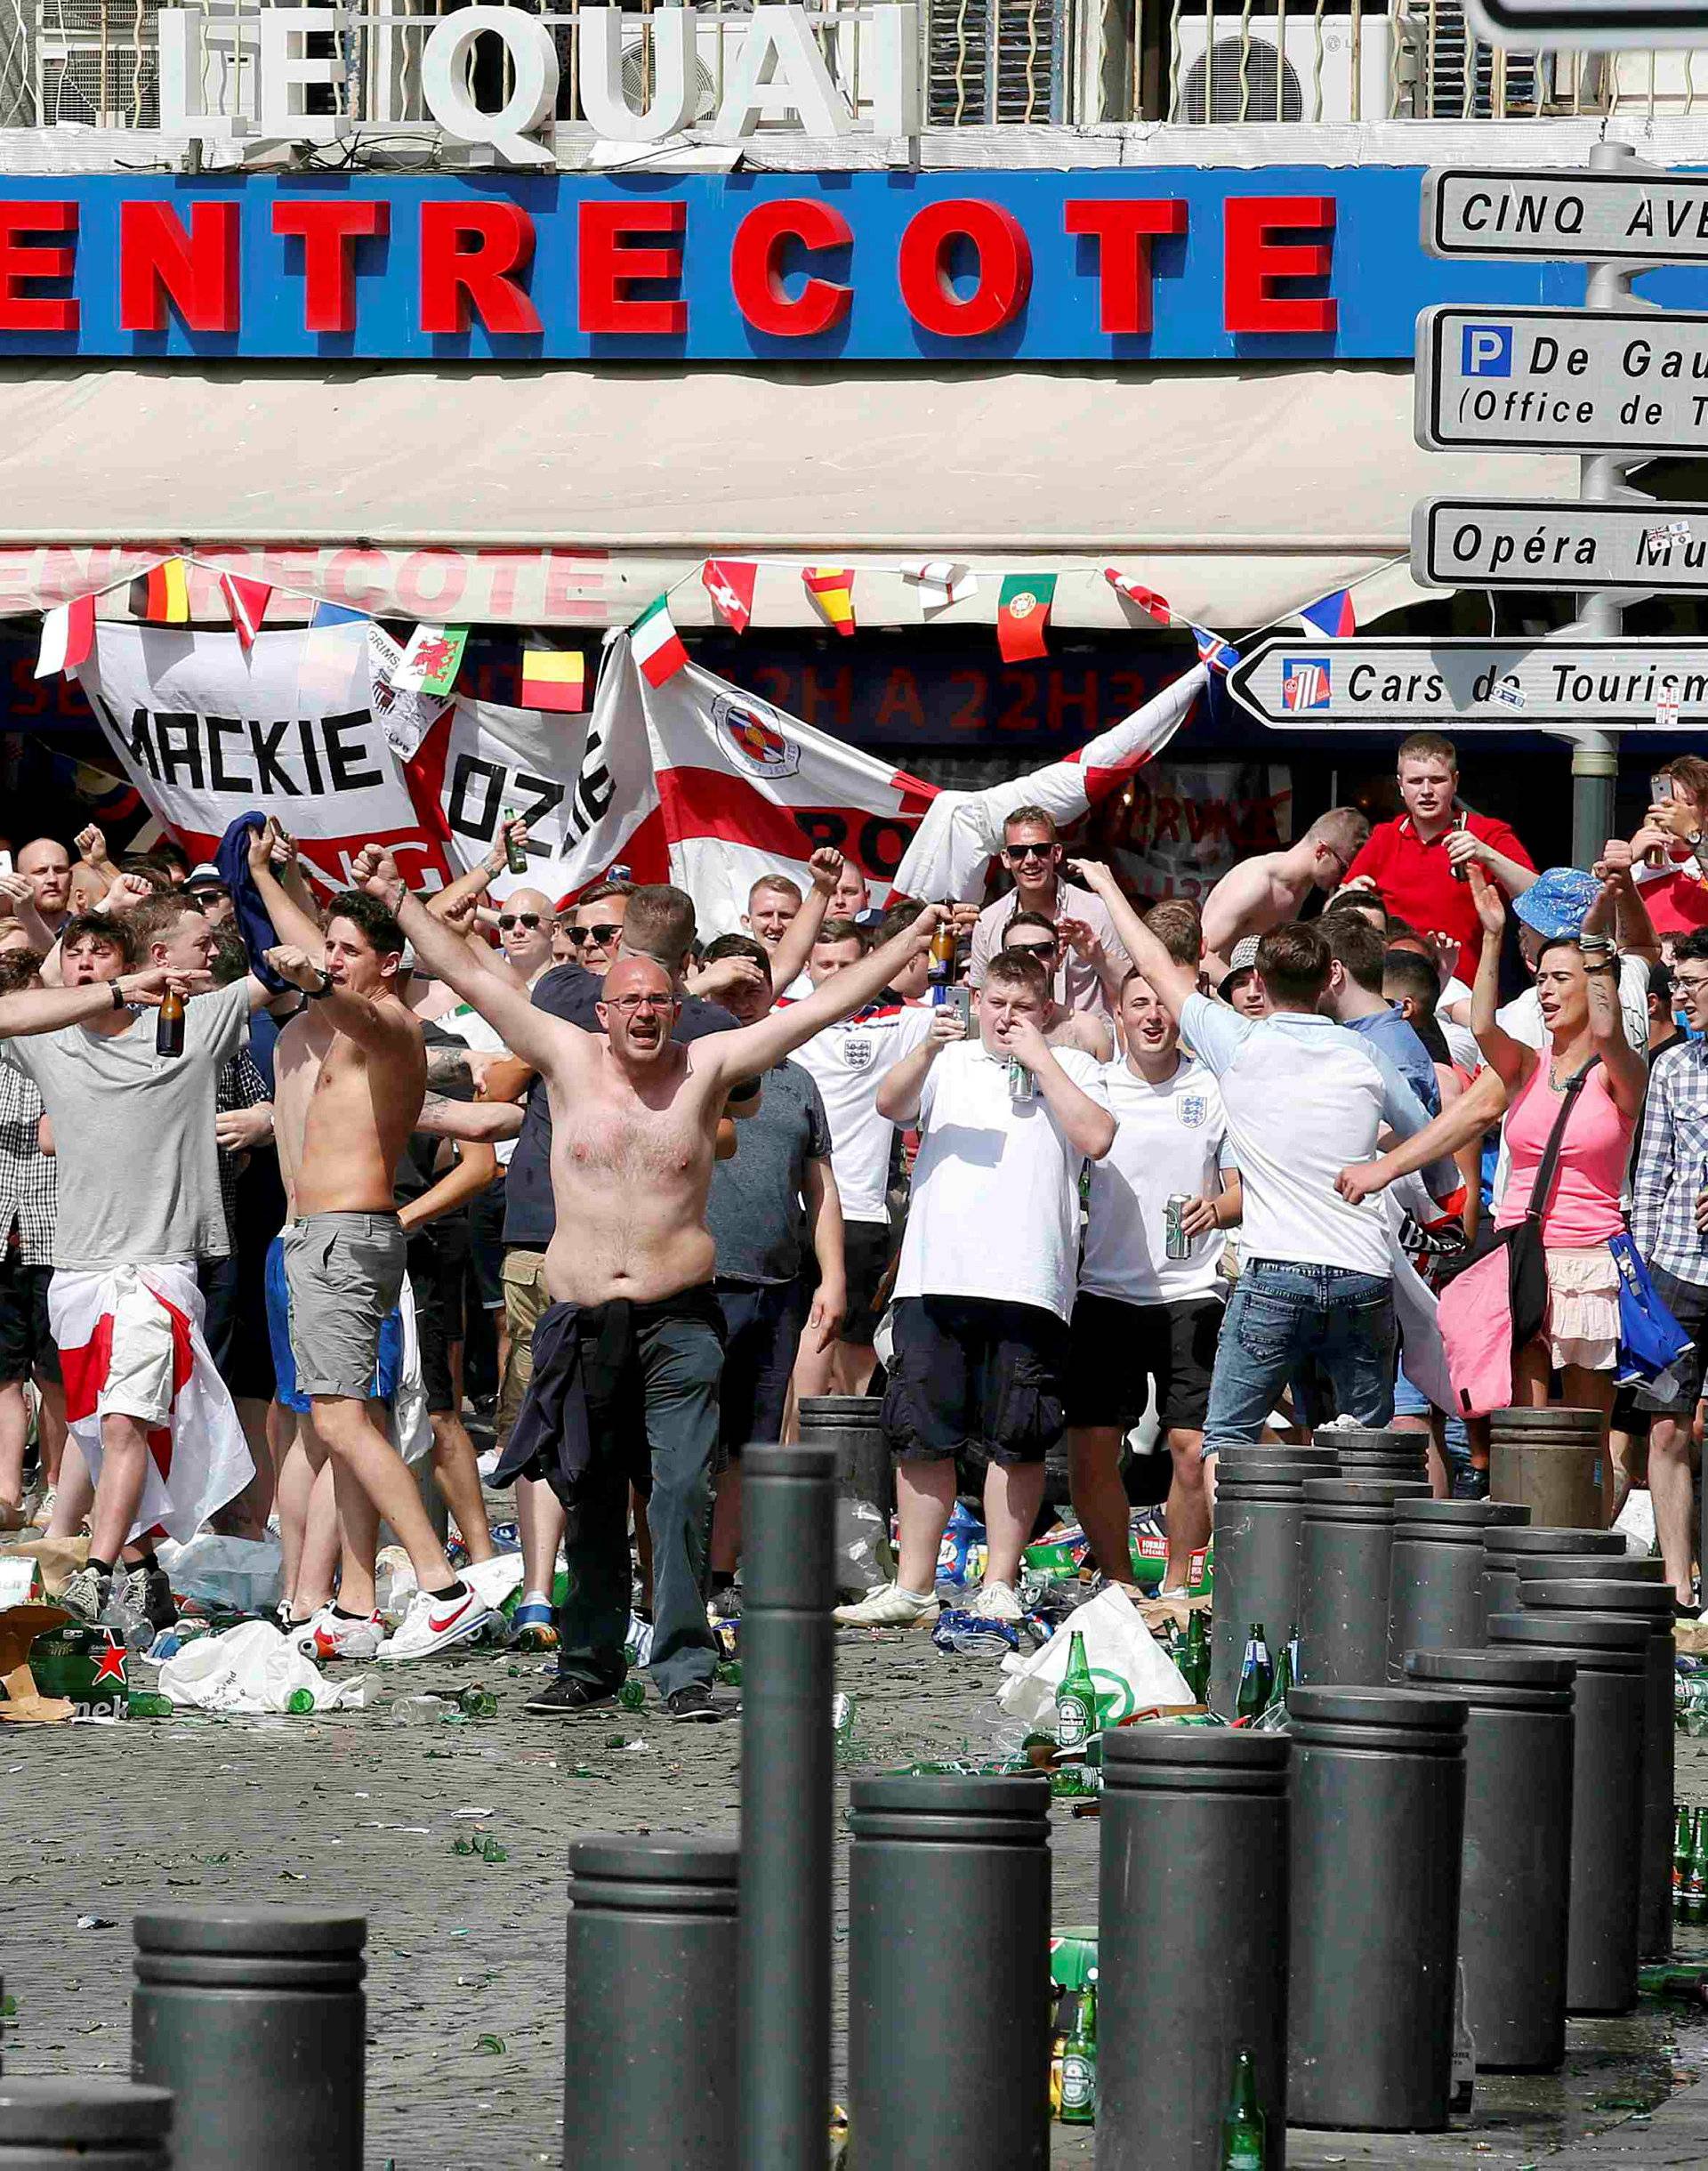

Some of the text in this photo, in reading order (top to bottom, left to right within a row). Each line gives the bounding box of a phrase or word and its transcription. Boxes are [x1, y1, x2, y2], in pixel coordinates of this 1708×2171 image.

[158, 4, 919, 166] LE QUAI
[1462, 194, 1584, 234] CINQ
[0, 198, 1338, 337] ENTRECOTE
[1529, 337, 1589, 376] De
[1623, 340, 1708, 378] Gau
[1459, 388, 1593, 424] (Office
[1621, 396, 1663, 424] de
[1453, 523, 1598, 573] Opéra
[1636, 529, 1707, 568] Mu
[367, 629, 400, 672] GRIMS
[1349, 664, 1443, 702] Cars
[97, 695, 383, 796] MACKIE
